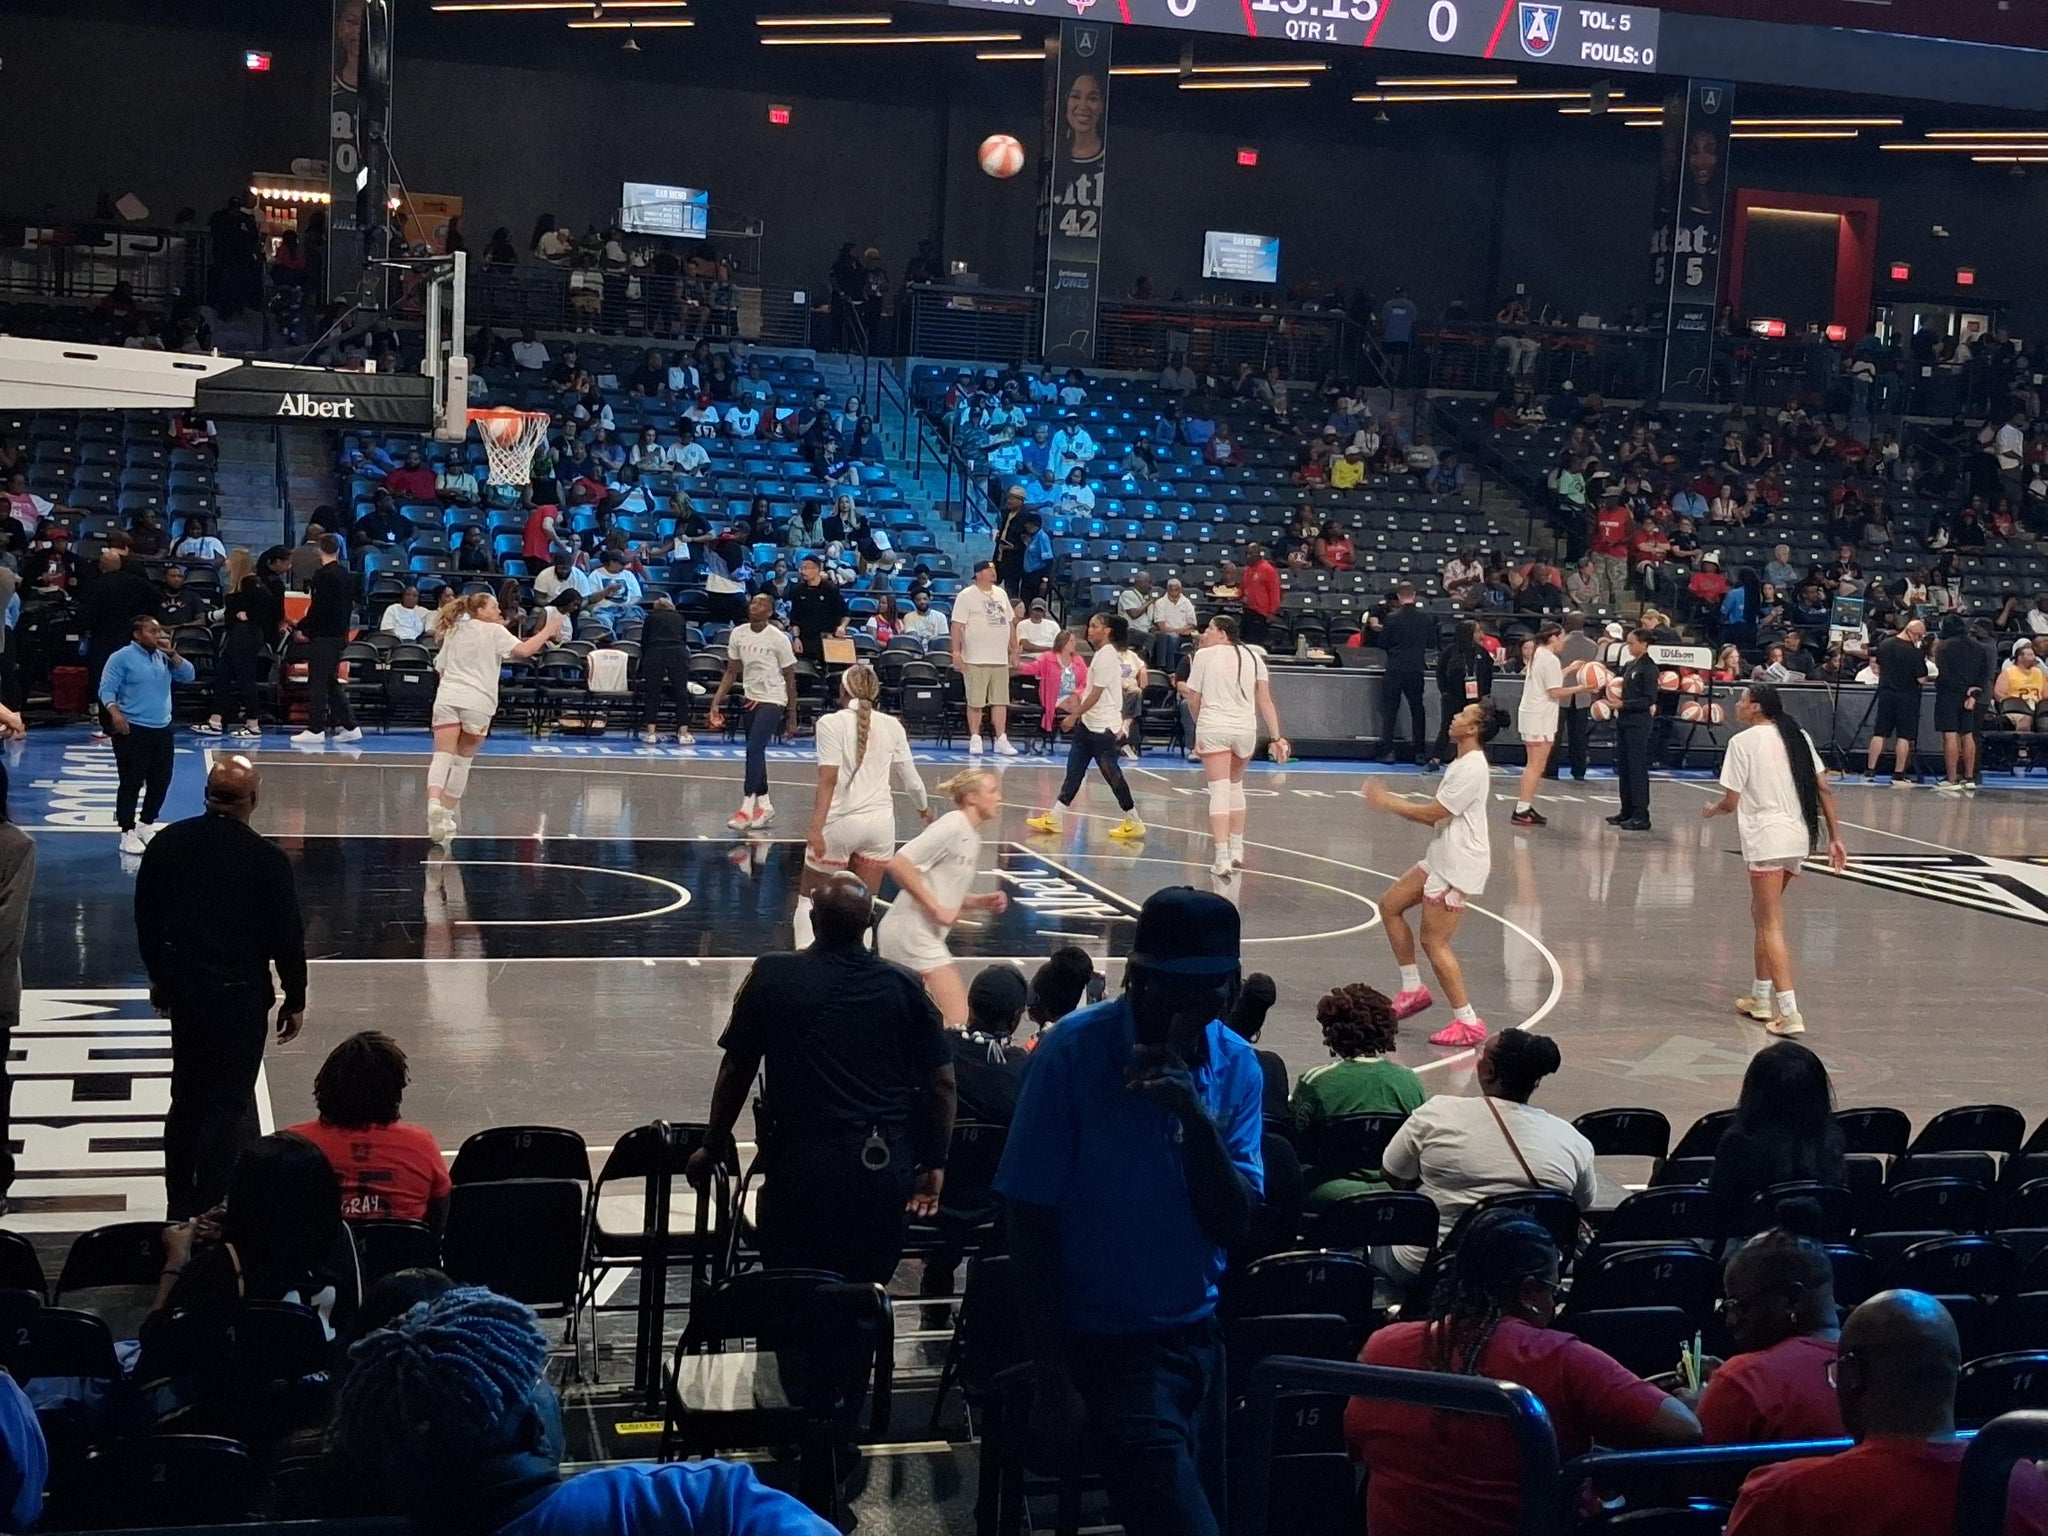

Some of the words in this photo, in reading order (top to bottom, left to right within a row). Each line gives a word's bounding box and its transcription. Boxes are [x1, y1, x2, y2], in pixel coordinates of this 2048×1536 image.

[1427, 0, 1457, 42] 0
[1579, 10, 1615, 31] TOL:
[1619, 14, 1632, 31] 5
[1284, 19, 1320, 41] QTR
[1324, 23, 1337, 41] 1
[1580, 42, 1639, 64] FOULS:
[1640, 48, 1655, 66] 0
[1058, 208, 1098, 237] 42
[1685, 257, 1704, 286] 5
[277, 393, 355, 419] Albert
[1660, 648, 1694, 659] Wilson
[1364, 1118, 1380, 1133] 14
[1615, 1114, 1630, 1129] 11
[1376, 1206, 1395, 1222] 13
[1671, 1200, 1686, 1216] 11
[1951, 1252, 1972, 1269] 10
[1305, 1266, 1327, 1284] 14
[1652, 1263, 1674, 1280] 12
[16, 1328, 31, 1346] 2
[2012, 1373, 2033, 1391] 11
[1295, 1408, 1320, 1427] 15
